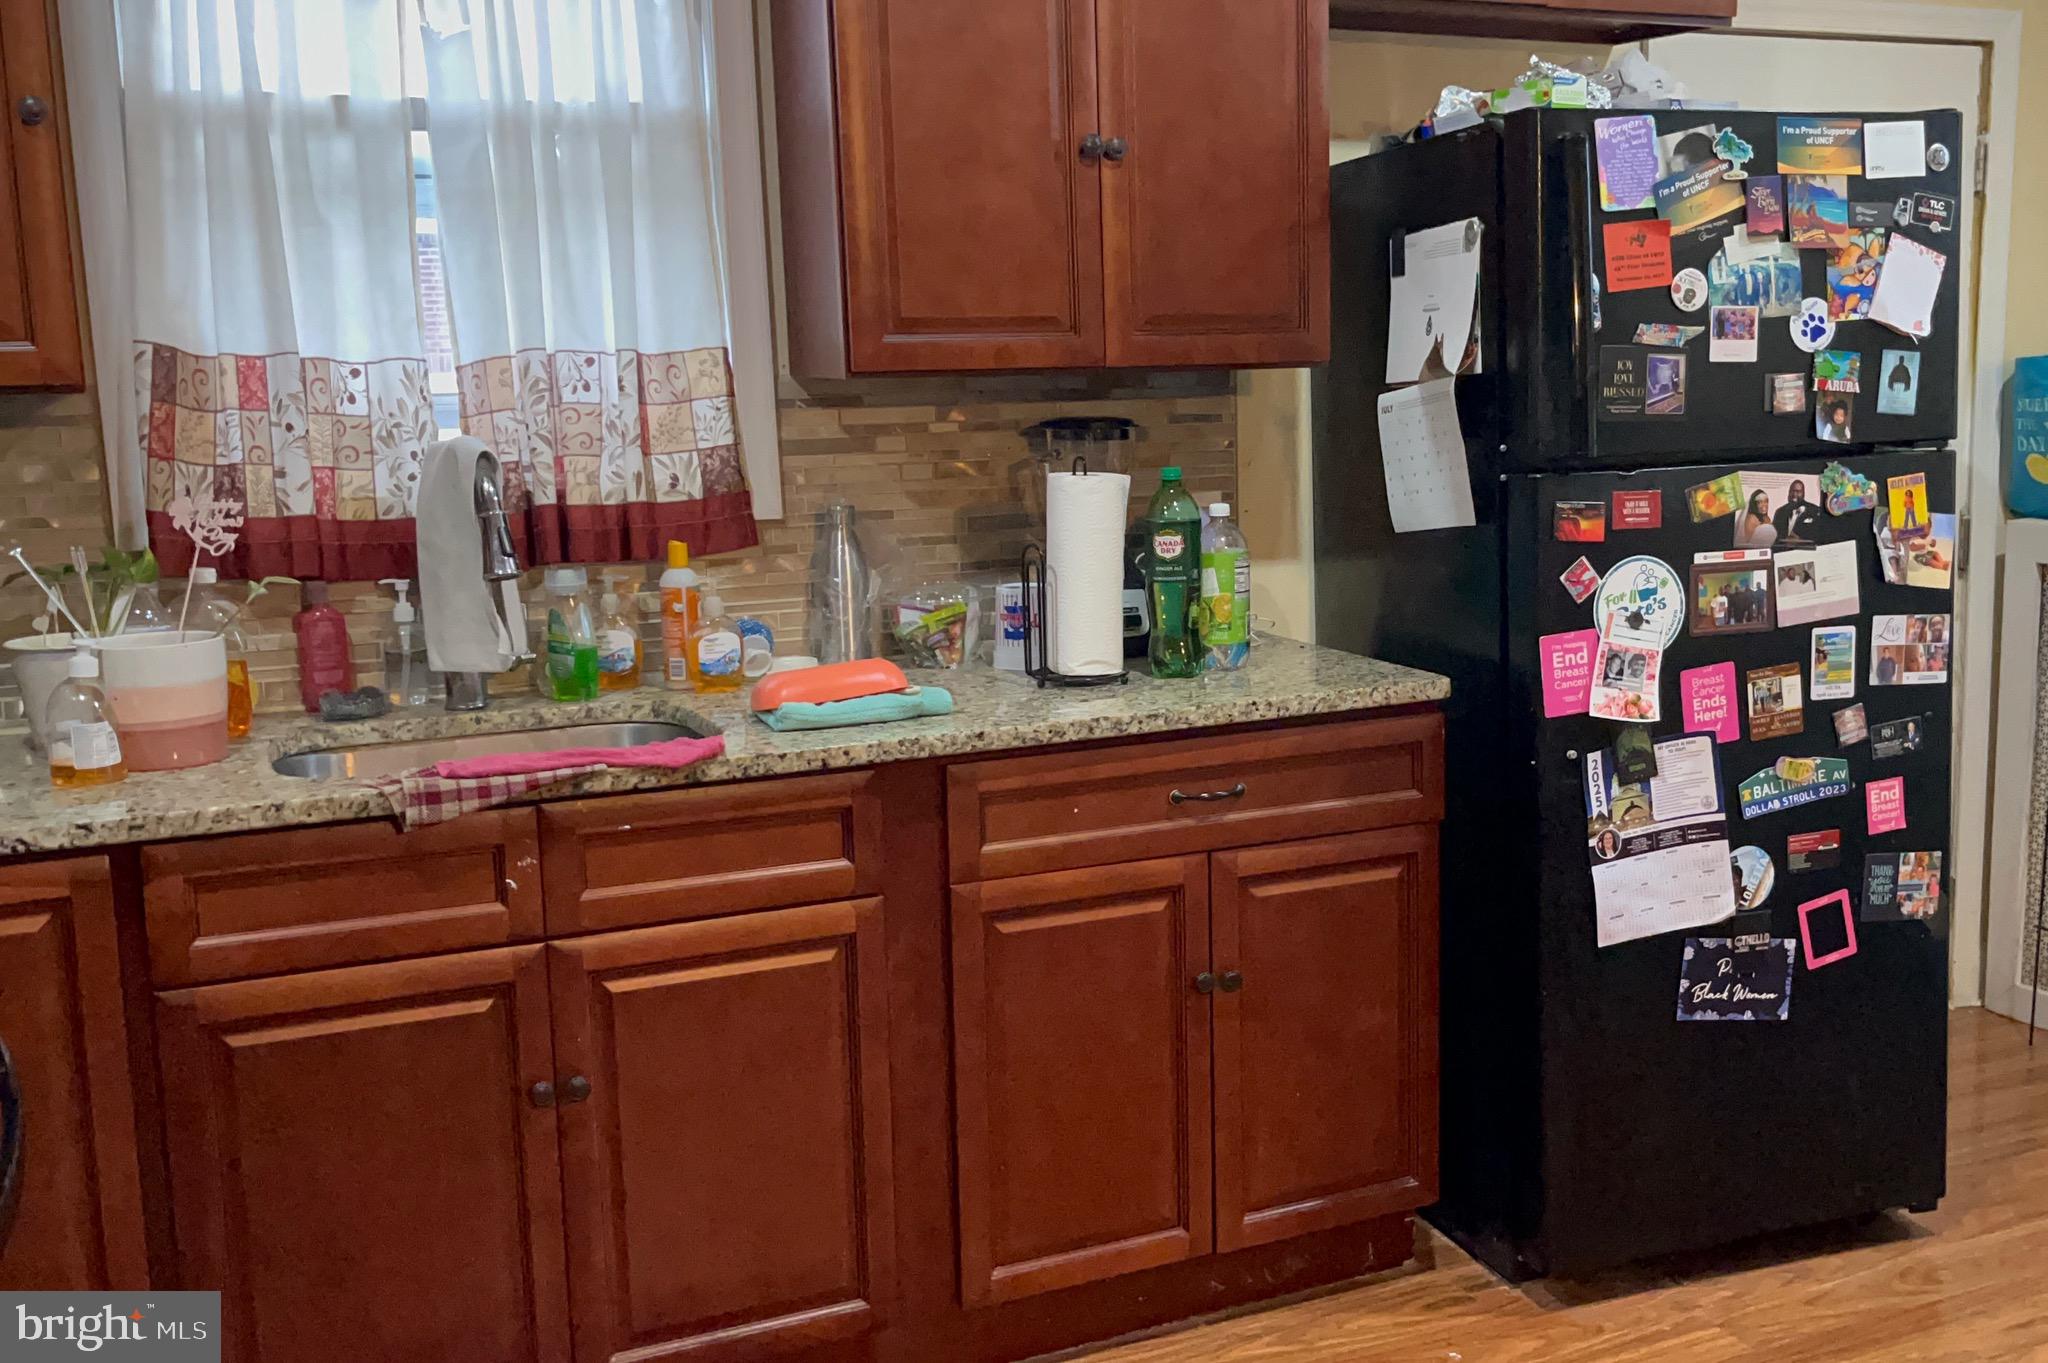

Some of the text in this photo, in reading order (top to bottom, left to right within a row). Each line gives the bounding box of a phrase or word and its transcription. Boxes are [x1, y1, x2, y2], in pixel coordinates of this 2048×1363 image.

[1599, 118, 1643, 140] Women
[1782, 126, 1794, 134] I'm
[1800, 126, 1822, 135] Proud
[1822, 127, 1857, 136] Supporter
[1806, 136, 1834, 145] of UNCF
[1658, 188, 1670, 198] I'm
[1674, 176, 1696, 191] Proud
[1695, 162, 1729, 180] Supporter
[1682, 179, 1710, 198] of UNCF
[1929, 199, 1945, 210] TLC
[1813, 378, 1860, 393] I ARUBA
[2017, 436, 2045, 452] DAY
[1152, 540, 1184, 548] CANADA
[1552, 647, 1589, 669] End
[1553, 665, 1589, 679] Breast
[1691, 673, 1725, 688] Breast
[1692, 684, 1725, 698] Cancer
[1693, 694, 1727, 711] Ends
[1695, 705, 1728, 724] Here!
[1832, 769, 1847, 781] AV
[1591, 758, 1603, 808] 2025
[1782, 787, 1816, 806] STROLL
[1819, 784, 1847, 797] 2023
[1871, 784, 1900, 804] End
[1871, 799, 1899, 813] Breast
[1735, 932, 1770, 947] OTHELLO
[1691, 981, 1778, 1003] Black Women
